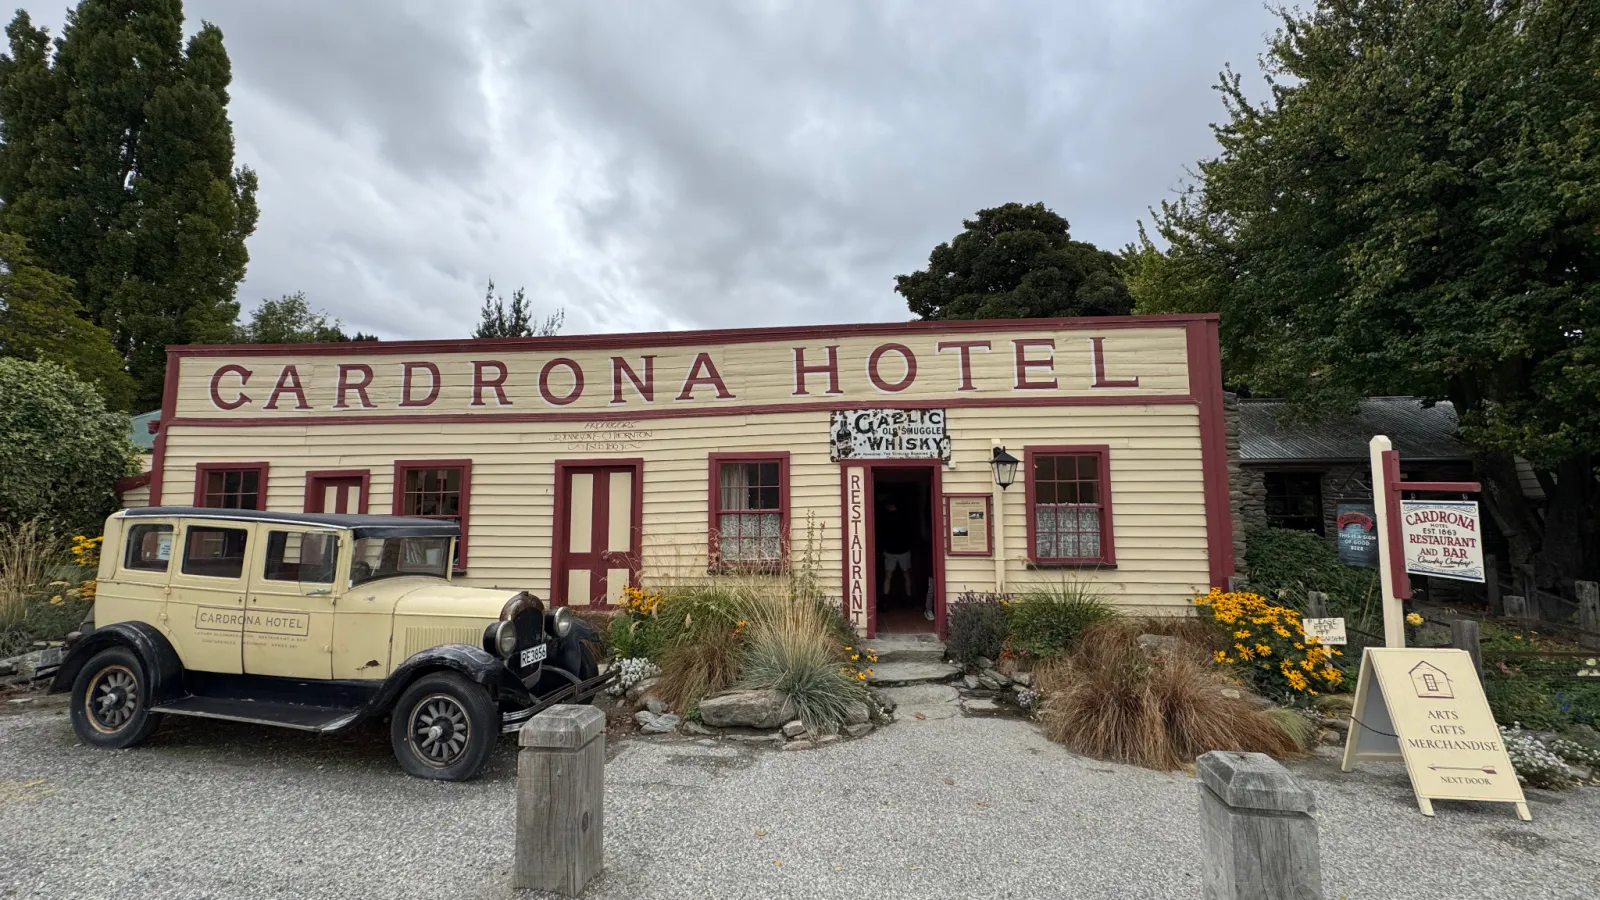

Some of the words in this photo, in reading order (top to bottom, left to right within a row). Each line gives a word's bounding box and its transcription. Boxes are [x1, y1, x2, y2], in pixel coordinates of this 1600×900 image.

[210, 353, 736, 410] CARDRONA
[792, 336, 1140, 396] HOTEL
[867, 436, 943, 450] WHISKY
[1405, 510, 1475, 532] CARDRONA
[1409, 534, 1476, 548] RESTAURANT
[850, 475, 863, 626] RESTAURANT
[1420, 548, 1438, 556] AND
[1443, 547, 1468, 559] BAR
[200, 612, 261, 626] CARDRONA
[266, 616, 303, 629] HOTEL
[522, 647, 546, 665] RE3856
[1428, 710, 1459, 720] ARTS
[1430, 724, 1466, 735] GIFTS
[1408, 738, 1499, 751] MERCHANDISE
[1440, 776, 1463, 784] NEXT
[1464, 777, 1492, 785] DOOR
